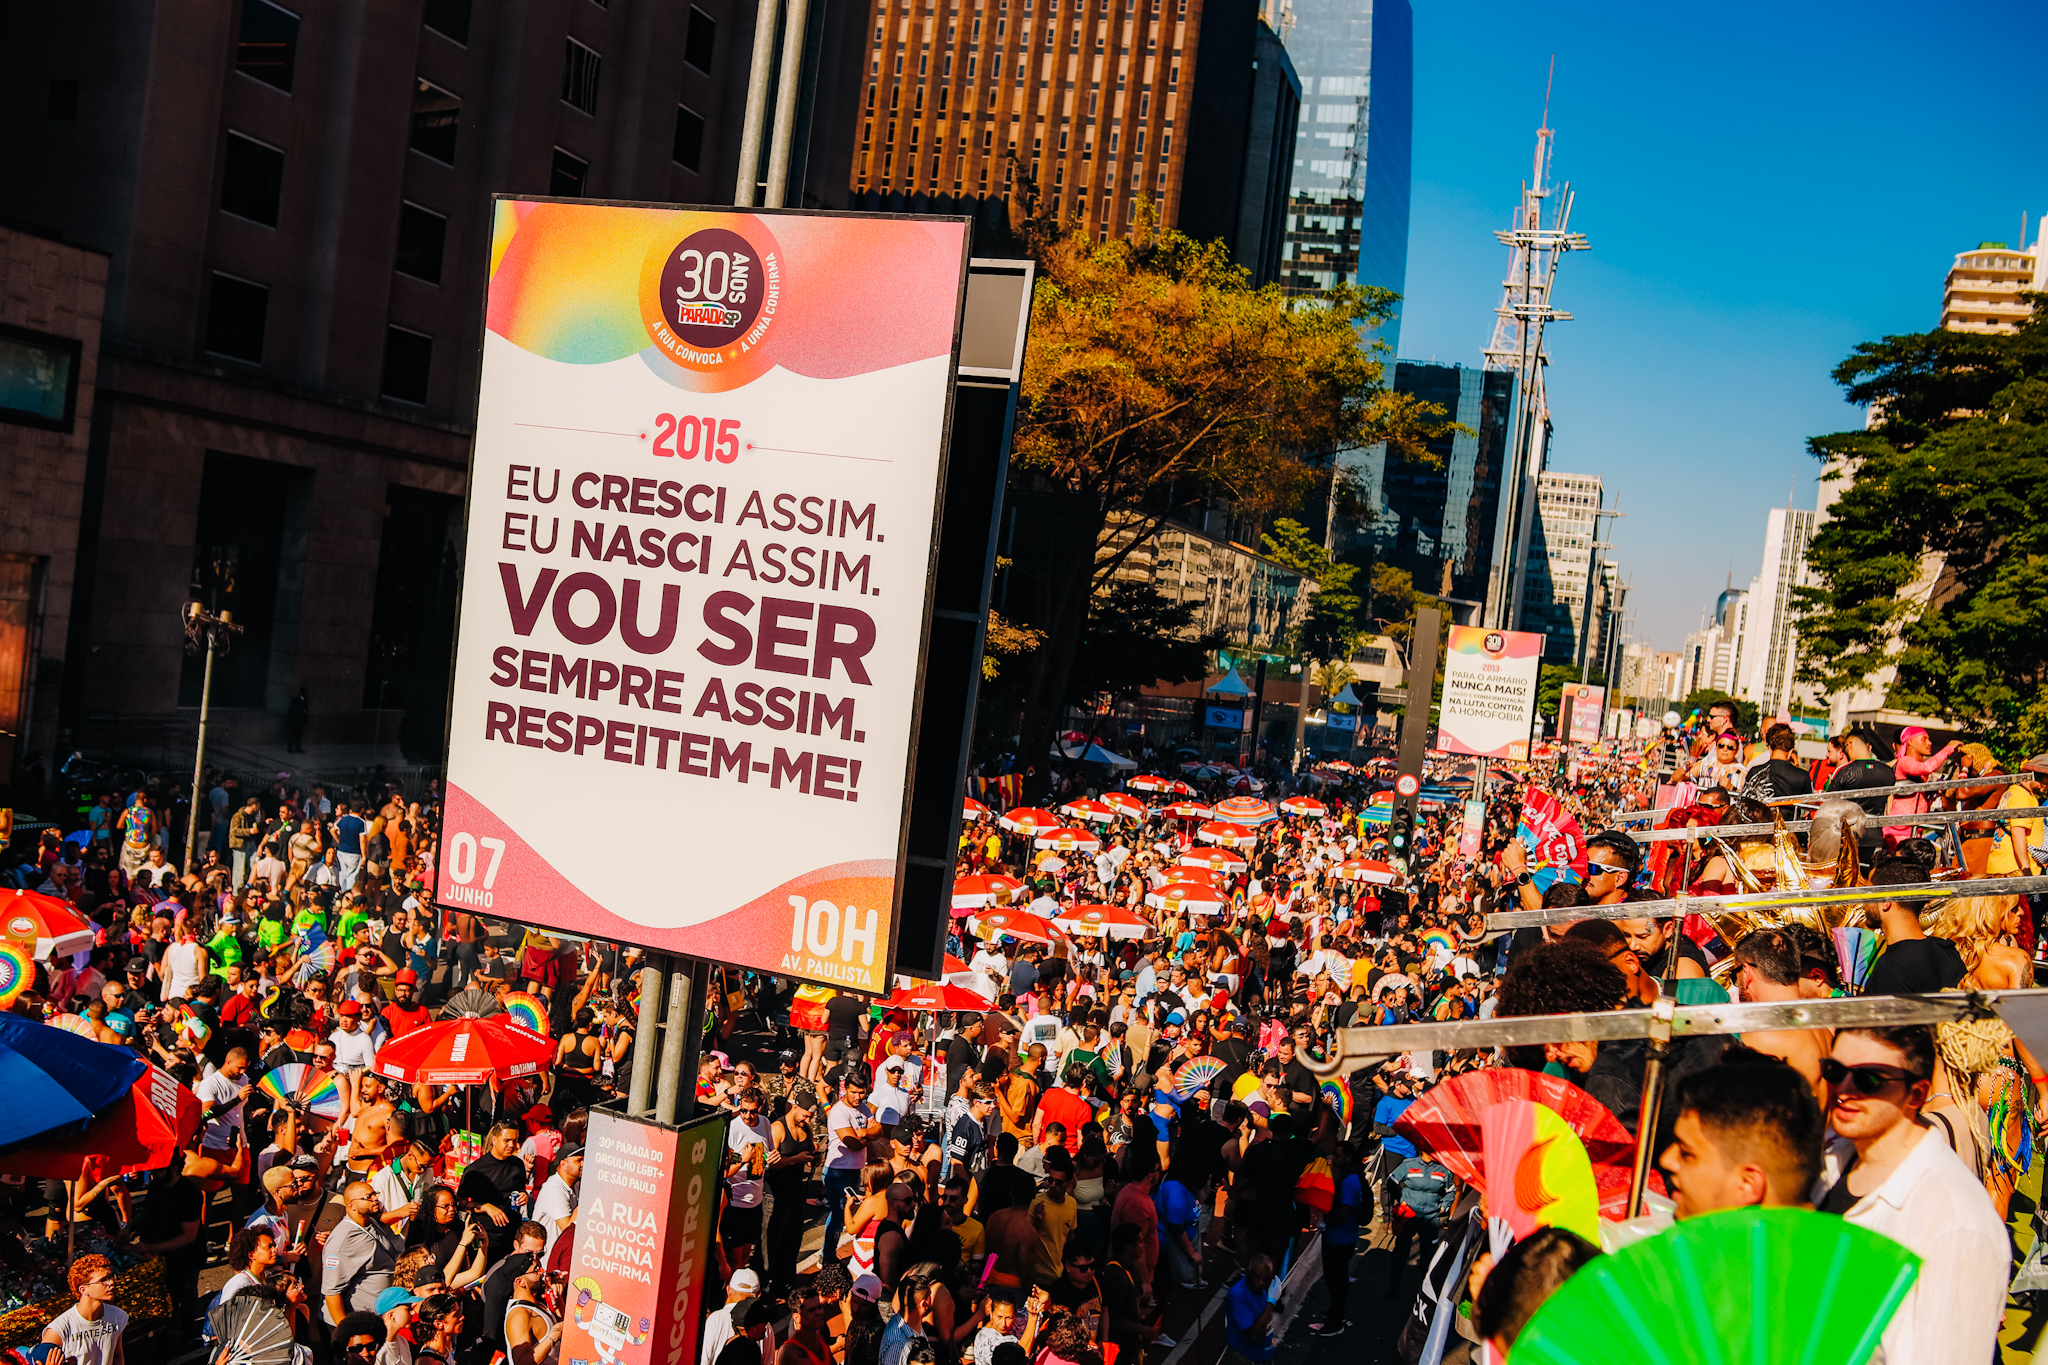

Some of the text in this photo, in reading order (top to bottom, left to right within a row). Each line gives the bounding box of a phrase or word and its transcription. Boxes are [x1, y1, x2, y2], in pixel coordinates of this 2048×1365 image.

[676, 249, 730, 301] 30
[728, 252, 750, 304] ANOS
[740, 252, 780, 353] A URNA CONFIRMA
[652, 321, 723, 364] A RUA CONVOCA
[652, 412, 742, 465] 2015
[506, 464, 885, 543] EU CRESCI ASSIM.
[502, 511, 881, 596] EU NASCI ASSIM.
[498, 562, 877, 687] VOU SER
[1452, 670, 1528, 686] PARA O ARMÁRIO
[1482, 663, 1500, 672] 2013
[489, 645, 867, 743] SEMPRE ASSIM.
[1451, 680, 1527, 697] NUNCA MAIS!
[1449, 697, 1524, 713] NA LUTA CONTRA
[1449, 706, 1524, 722] A HOMOFOBIA
[485, 700, 863, 803] RESPEITEM-ME!
[1439, 735, 1453, 748] 07
[1508, 744, 1527, 757] 10H
[1468, 804, 1483, 815] 30
[448, 832, 506, 888] 07
[445, 884, 494, 909] JUNHO
[788, 895, 879, 967] 10H
[781, 952, 873, 987] AV. PAULISTA
[510, 1062, 537, 1076] BRAHMA
[616, 1139, 650, 1160] PARADA
[651, 1150, 663, 1163] DO
[691, 1138, 707, 1165] 8
[955, 1136, 968, 1149] 80
[595, 1153, 665, 1179] ORGULHO LGBT+
[597, 1169, 656, 1195] DE SÃO PAULO
[588, 1197, 658, 1233] A RUA
[586, 1219, 656, 1250] CONVOCA
[582, 1235, 653, 1269] A URNA
[581, 1254, 652, 1285] CONFIRMA
[76, 1328, 100, 1341] HATE
